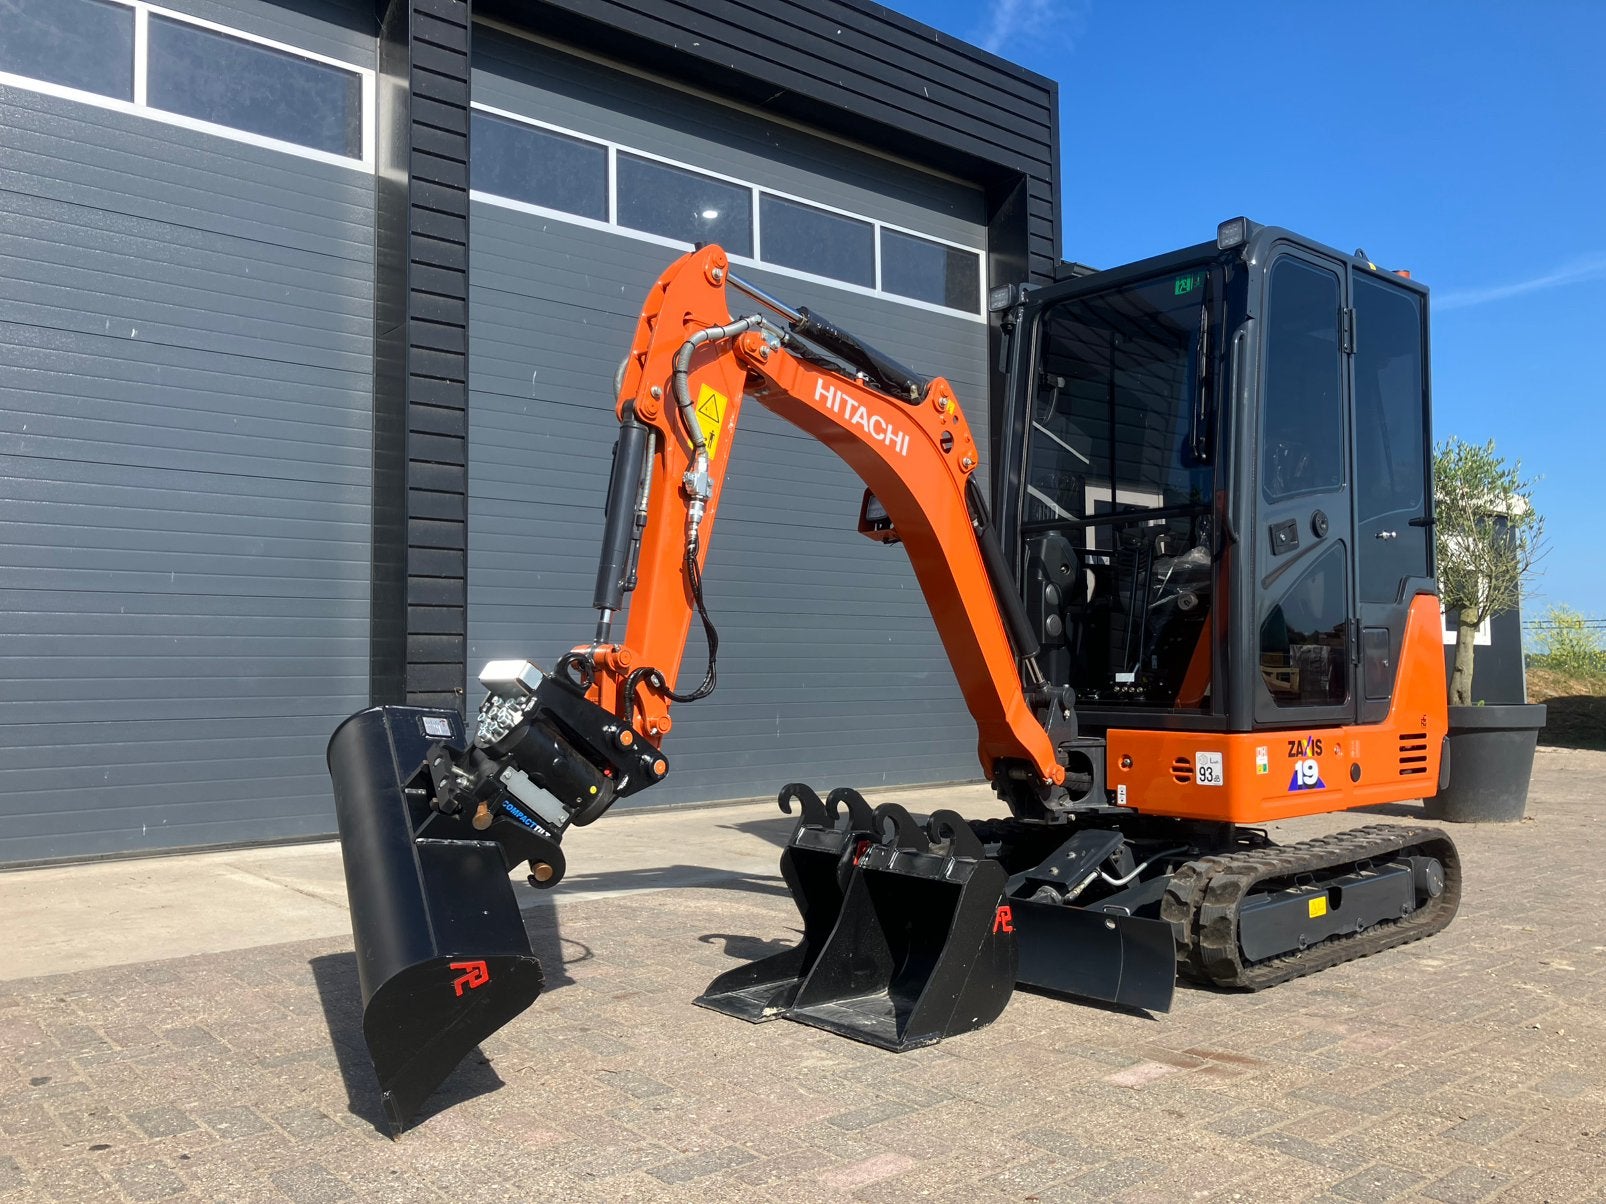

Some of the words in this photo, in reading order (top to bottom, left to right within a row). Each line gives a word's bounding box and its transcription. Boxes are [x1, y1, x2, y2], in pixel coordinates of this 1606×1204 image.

[814, 377, 910, 457] HITACHI
[1288, 736, 1323, 758] ZAXIS
[1199, 766, 1213, 782] 93
[1295, 759, 1319, 785] 19
